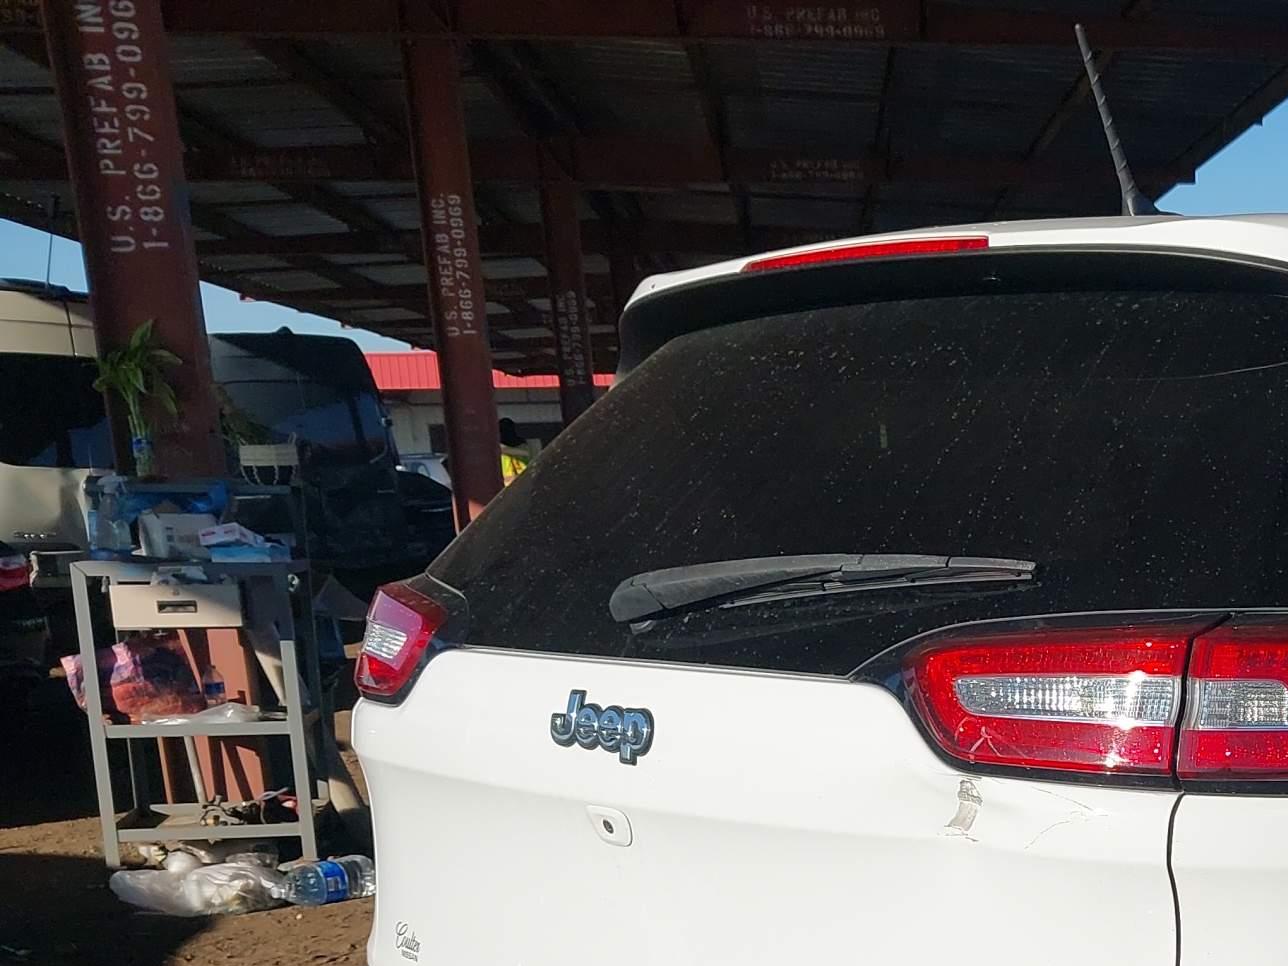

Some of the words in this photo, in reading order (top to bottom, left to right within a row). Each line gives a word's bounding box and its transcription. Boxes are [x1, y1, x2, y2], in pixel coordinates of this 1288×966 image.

[83, 52, 127, 175] PREFAB
[107, 195, 136, 252] U.S.
[431, 192, 448, 225] INC.
[435, 233, 456, 296] PREFAB
[447, 194, 478, 335] 1-866-799-0969
[550, 688, 655, 766] Jeep
